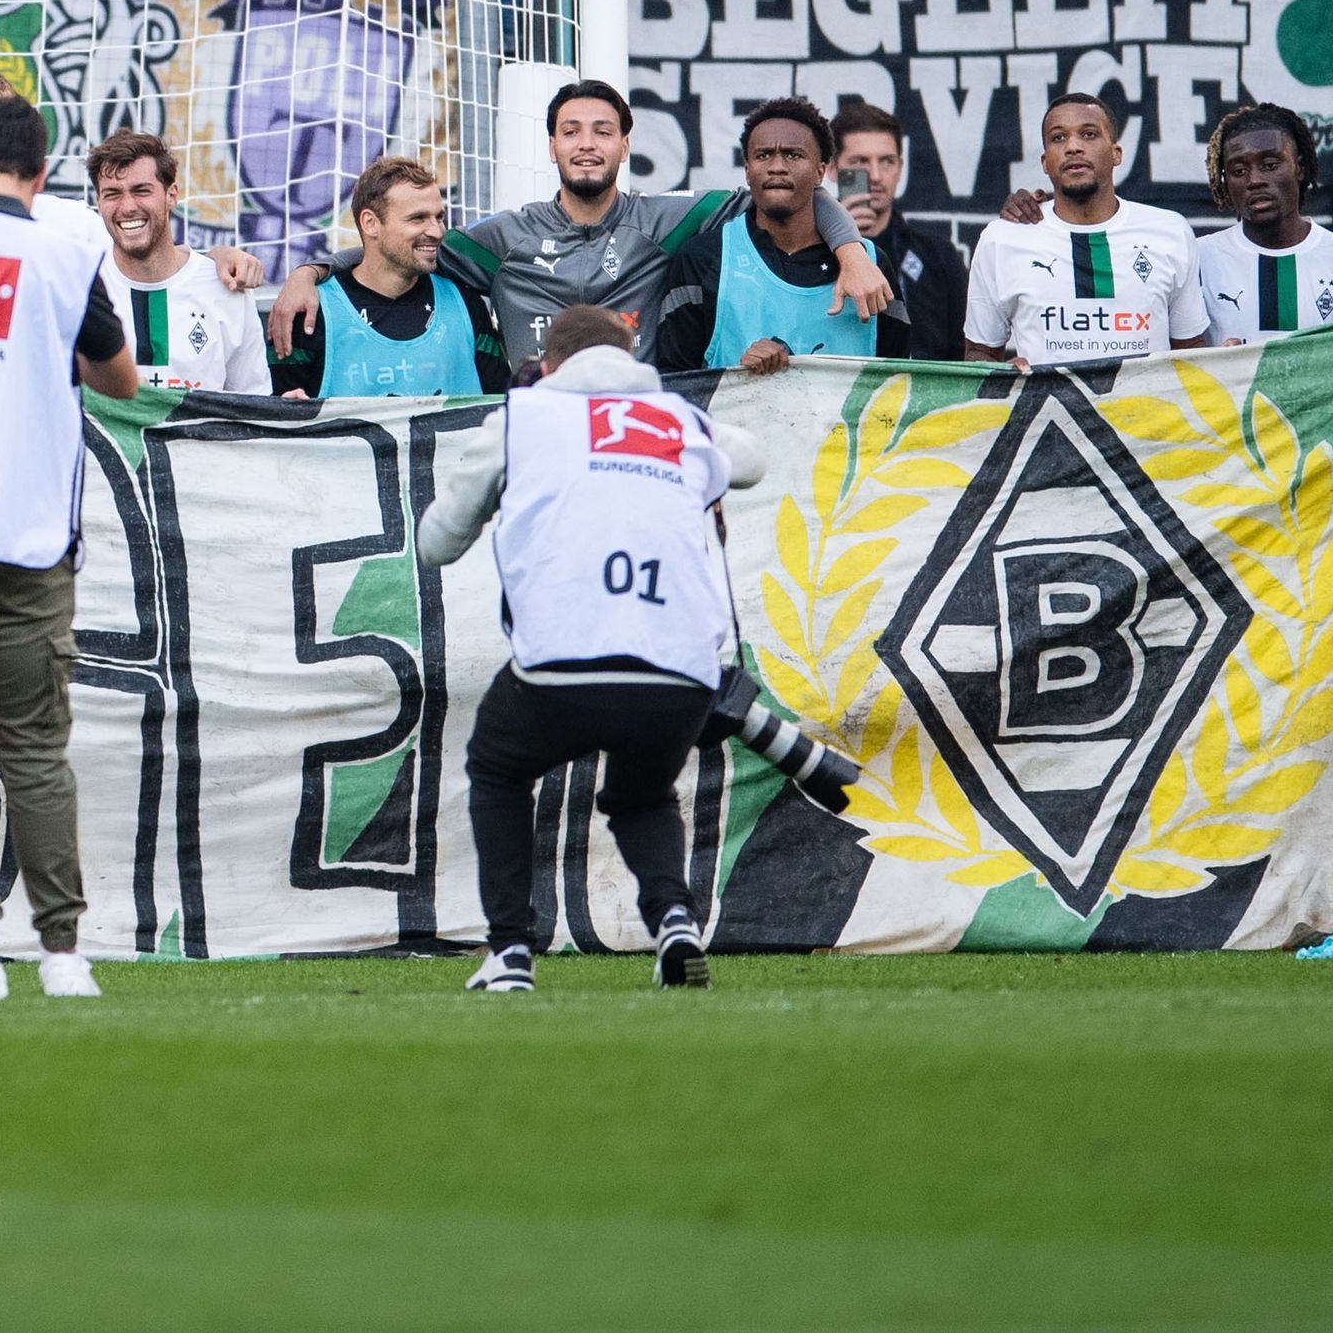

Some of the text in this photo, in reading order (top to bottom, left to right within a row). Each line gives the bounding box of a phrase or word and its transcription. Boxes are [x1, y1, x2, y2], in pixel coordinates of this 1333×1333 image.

[1045, 337, 1150, 353] Invest in yourself
[588, 459, 685, 486] BUNDESLIGA
[603, 549, 666, 606] 01
